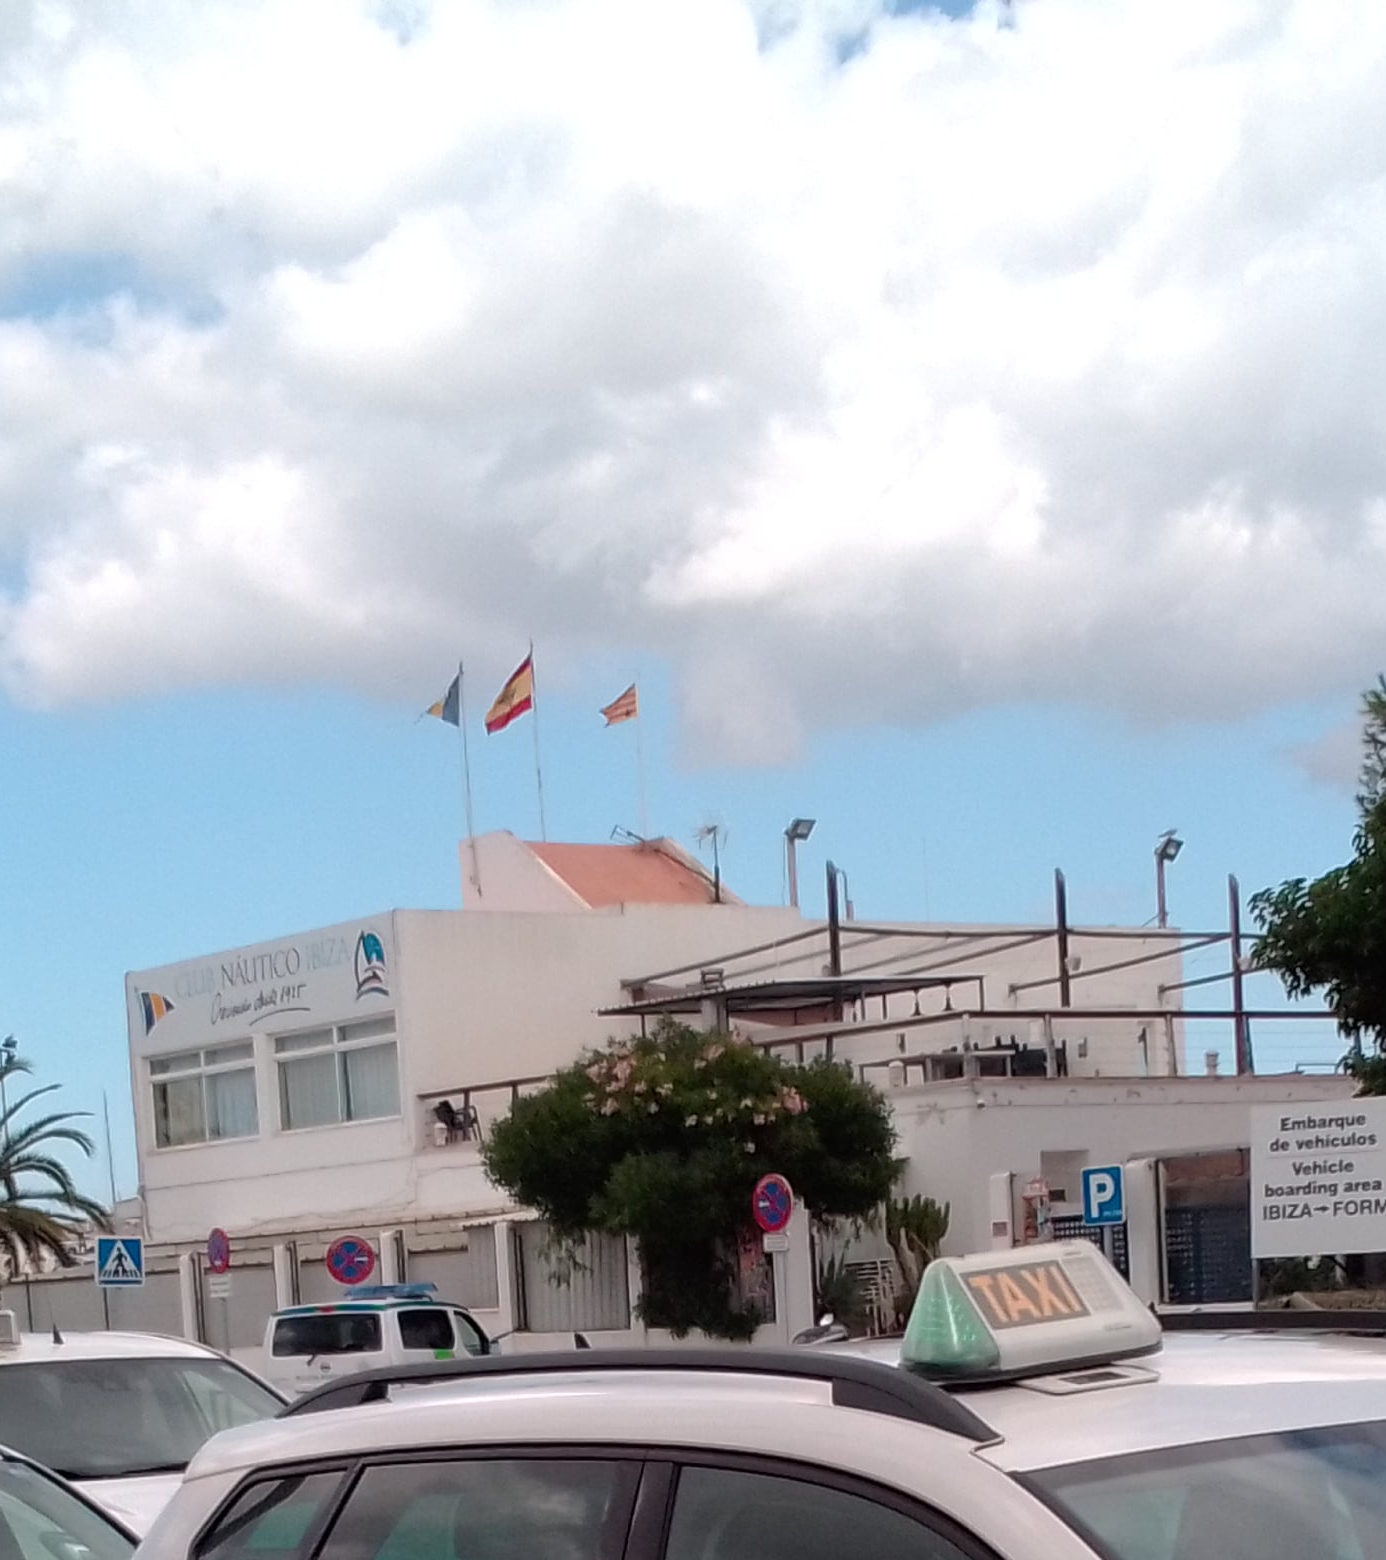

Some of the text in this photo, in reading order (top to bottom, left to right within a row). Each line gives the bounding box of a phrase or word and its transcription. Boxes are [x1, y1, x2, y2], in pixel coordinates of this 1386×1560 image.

[221, 947, 301, 987] NÁUTICO
[305, 936, 351, 971] IBIZA
[1280, 1113, 1366, 1132] Embarque
[1269, 1138, 1290, 1152] de
[1292, 1159, 1354, 1176] Vehicle
[1089, 1174, 1115, 1218] P
[1265, 1179, 1382, 1199] boarding area
[1263, 1203, 1313, 1221] IBIZA
[968, 1266, 1083, 1323] TAXI
